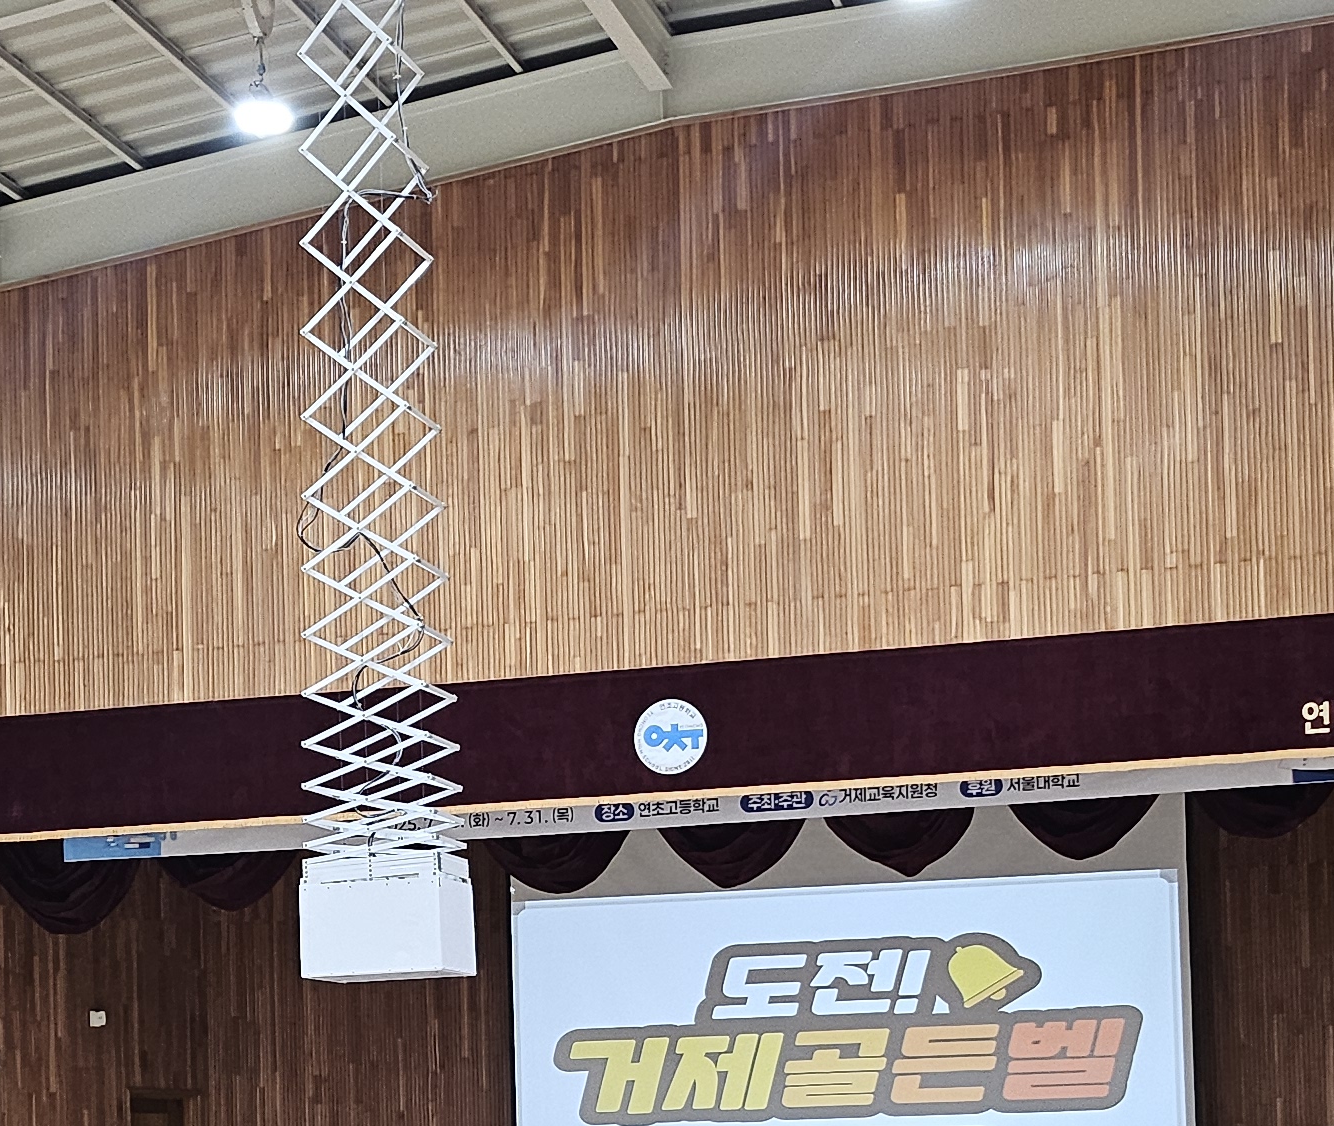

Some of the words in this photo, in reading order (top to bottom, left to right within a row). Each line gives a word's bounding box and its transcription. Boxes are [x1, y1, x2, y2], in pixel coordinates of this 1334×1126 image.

[601, 804, 629, 820] 장소
[638, 798, 720, 818] 연초고등학교
[838, 782, 939, 804] 거제교육지원청
[1007, 773, 1081, 792] 서울대학교
[711, 948, 932, 1020] 도전!
